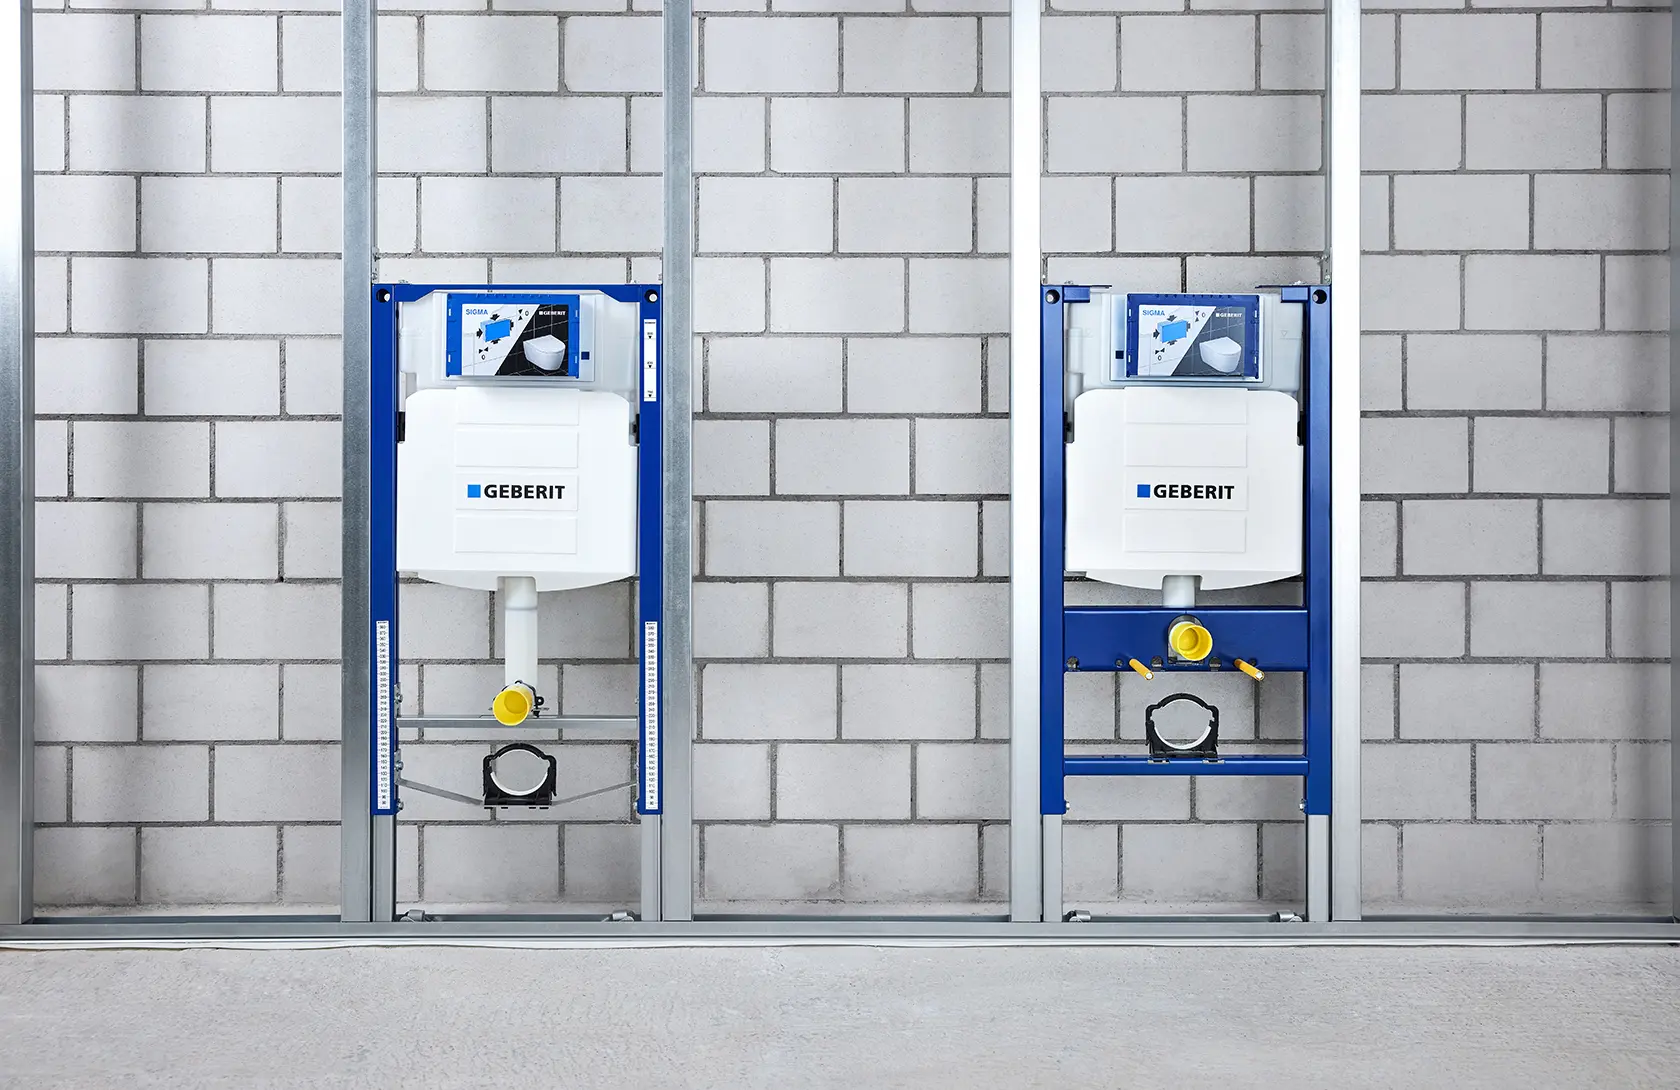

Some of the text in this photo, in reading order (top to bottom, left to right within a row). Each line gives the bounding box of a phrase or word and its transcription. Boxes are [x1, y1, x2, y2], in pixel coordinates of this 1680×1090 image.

[465, 308, 489, 316] SIGMA
[1142, 309, 1166, 317] SIGMA
[483, 484, 566, 500] GEBERIT
[1153, 484, 1235, 500] GEBERIT
